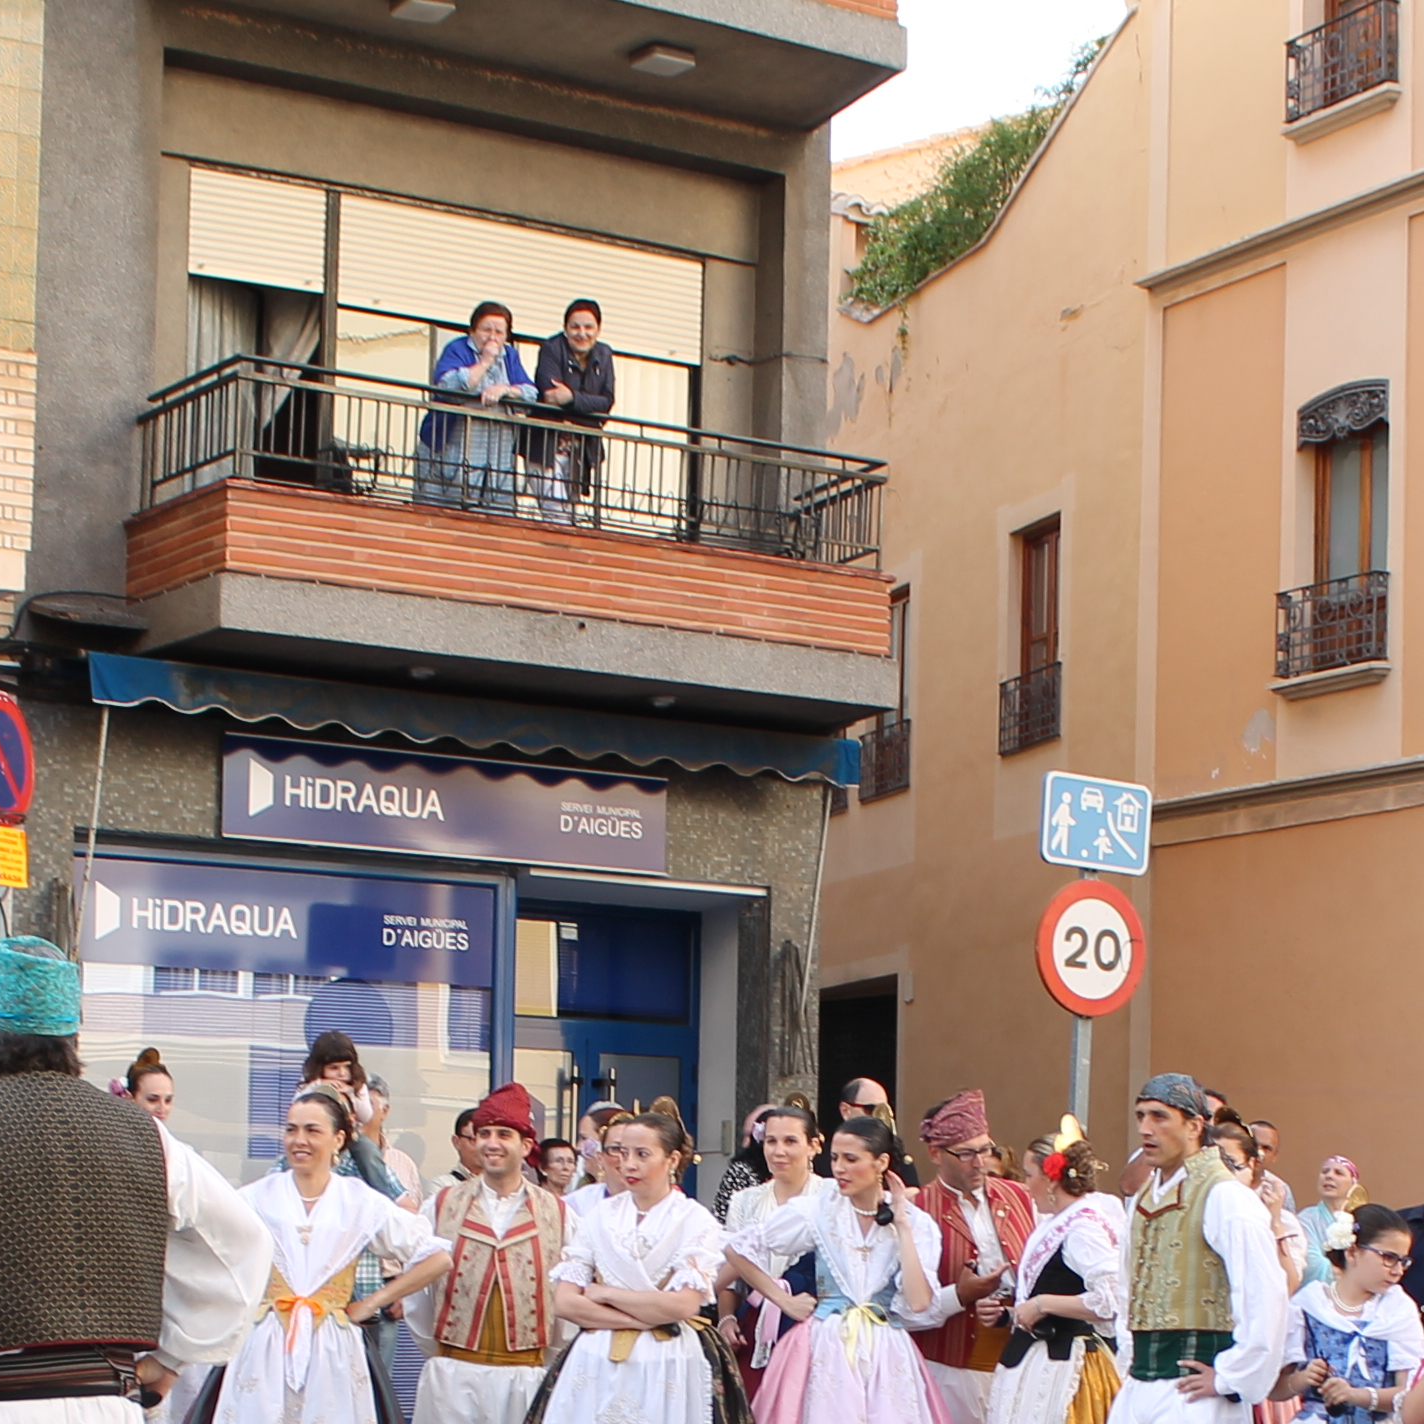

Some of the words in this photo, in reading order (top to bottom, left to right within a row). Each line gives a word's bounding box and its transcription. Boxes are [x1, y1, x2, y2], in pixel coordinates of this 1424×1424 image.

[560, 801, 593, 814] SERVEI
[596, 805, 643, 819] MUNICIPAL
[383, 914, 417, 927] SERVEI
[420, 916, 469, 930] MUNICIPAL
[1064, 926, 1121, 972] 20
